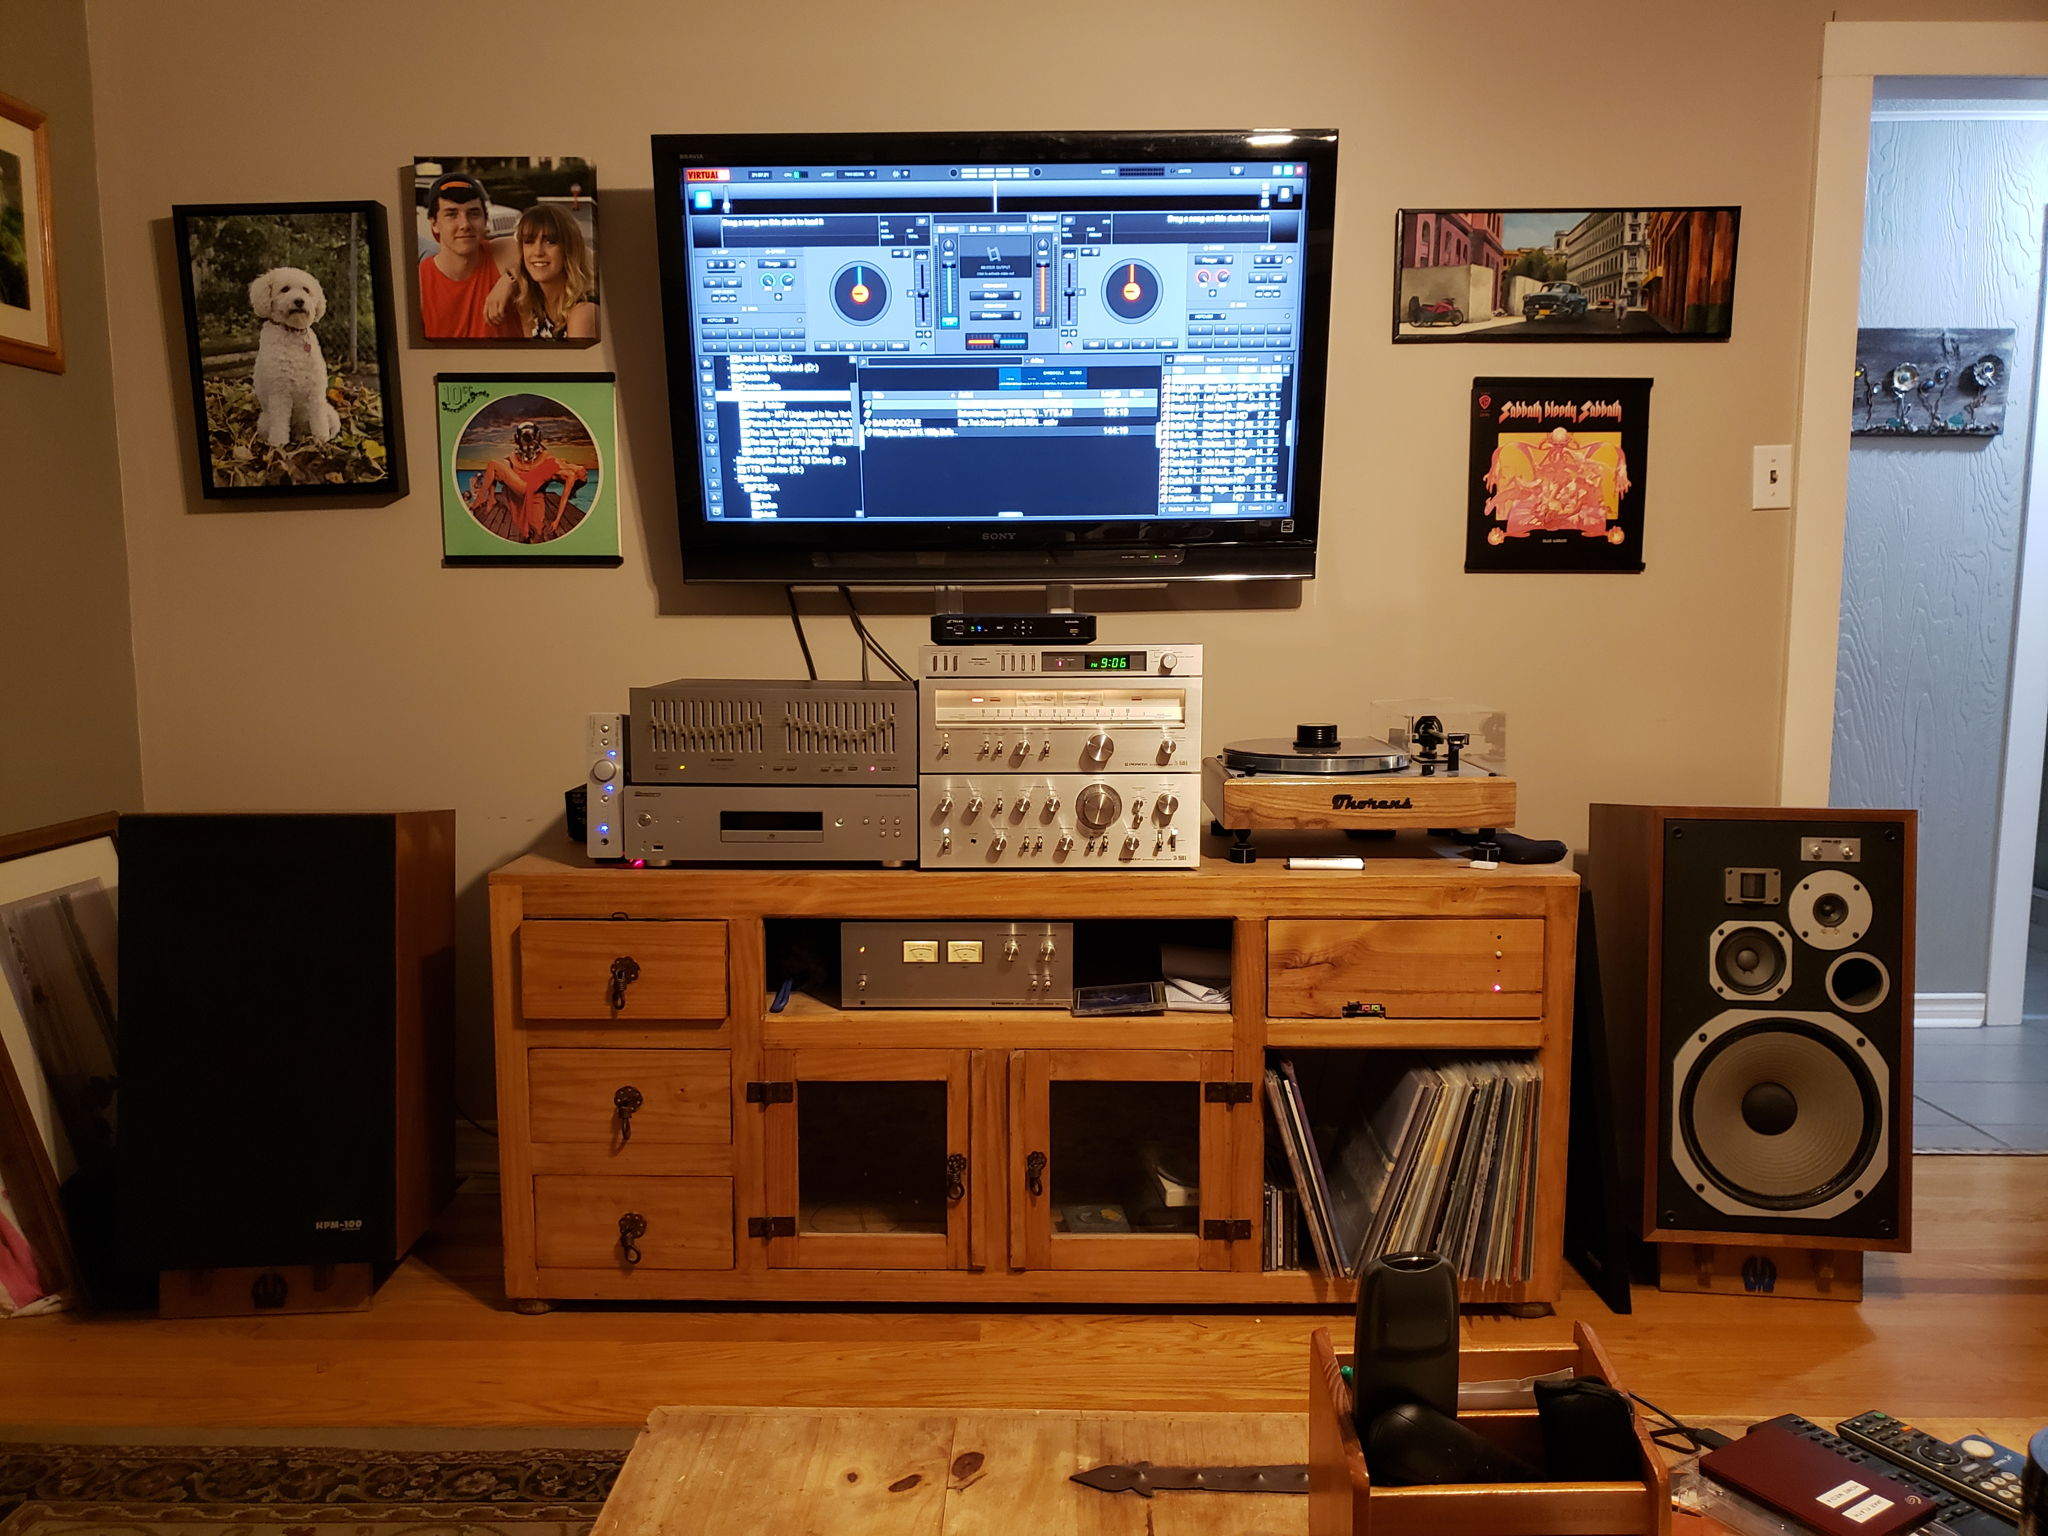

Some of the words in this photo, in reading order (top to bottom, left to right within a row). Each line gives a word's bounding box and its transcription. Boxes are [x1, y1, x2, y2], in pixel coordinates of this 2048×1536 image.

[687, 170, 718, 180] VIRTUAL
[1498, 400, 1542, 424] Sabbath
[1544, 400, 1576, 424] bloody
[1578, 400, 1622, 424] Sabbath
[1101, 657, 1127, 668] 9:06
[1332, 794, 1413, 810] Thorens
[316, 1219, 362, 1230] HPM-100
